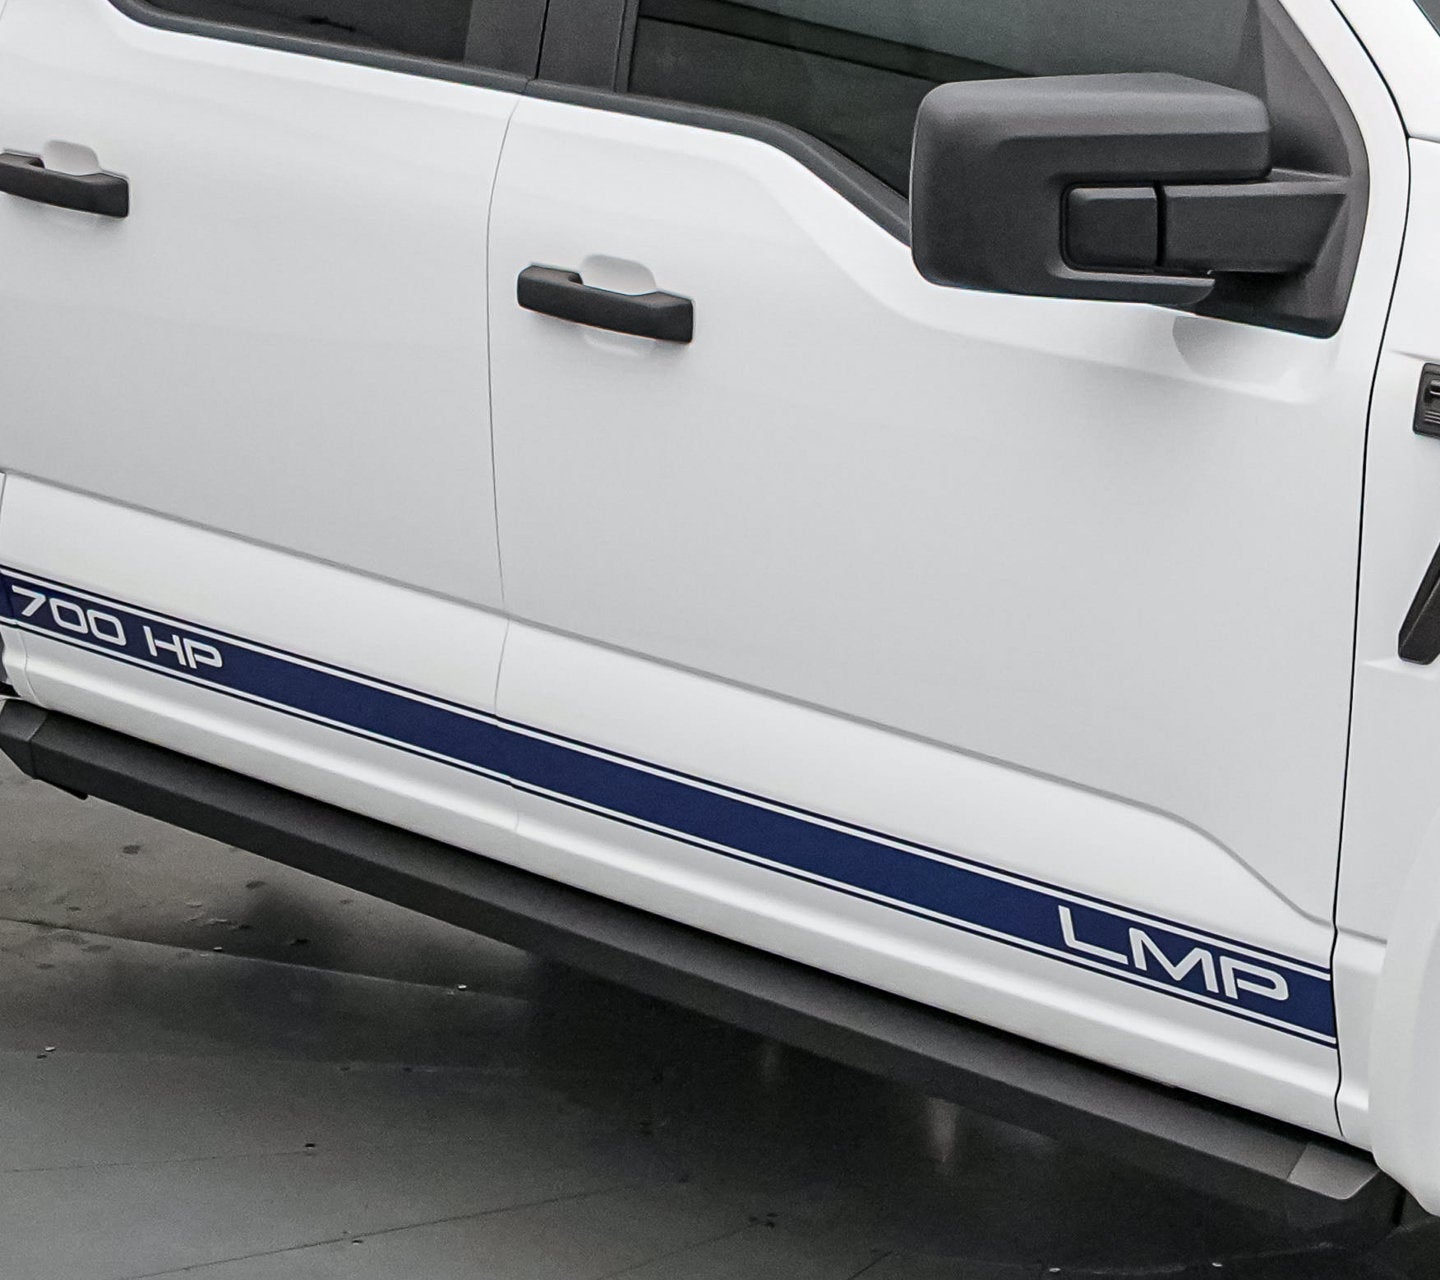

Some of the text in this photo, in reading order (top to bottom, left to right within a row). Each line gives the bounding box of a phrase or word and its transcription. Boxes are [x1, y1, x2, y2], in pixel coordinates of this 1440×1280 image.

[11, 584, 223, 669] 700 HP
[1058, 905, 1289, 1001] LMP
